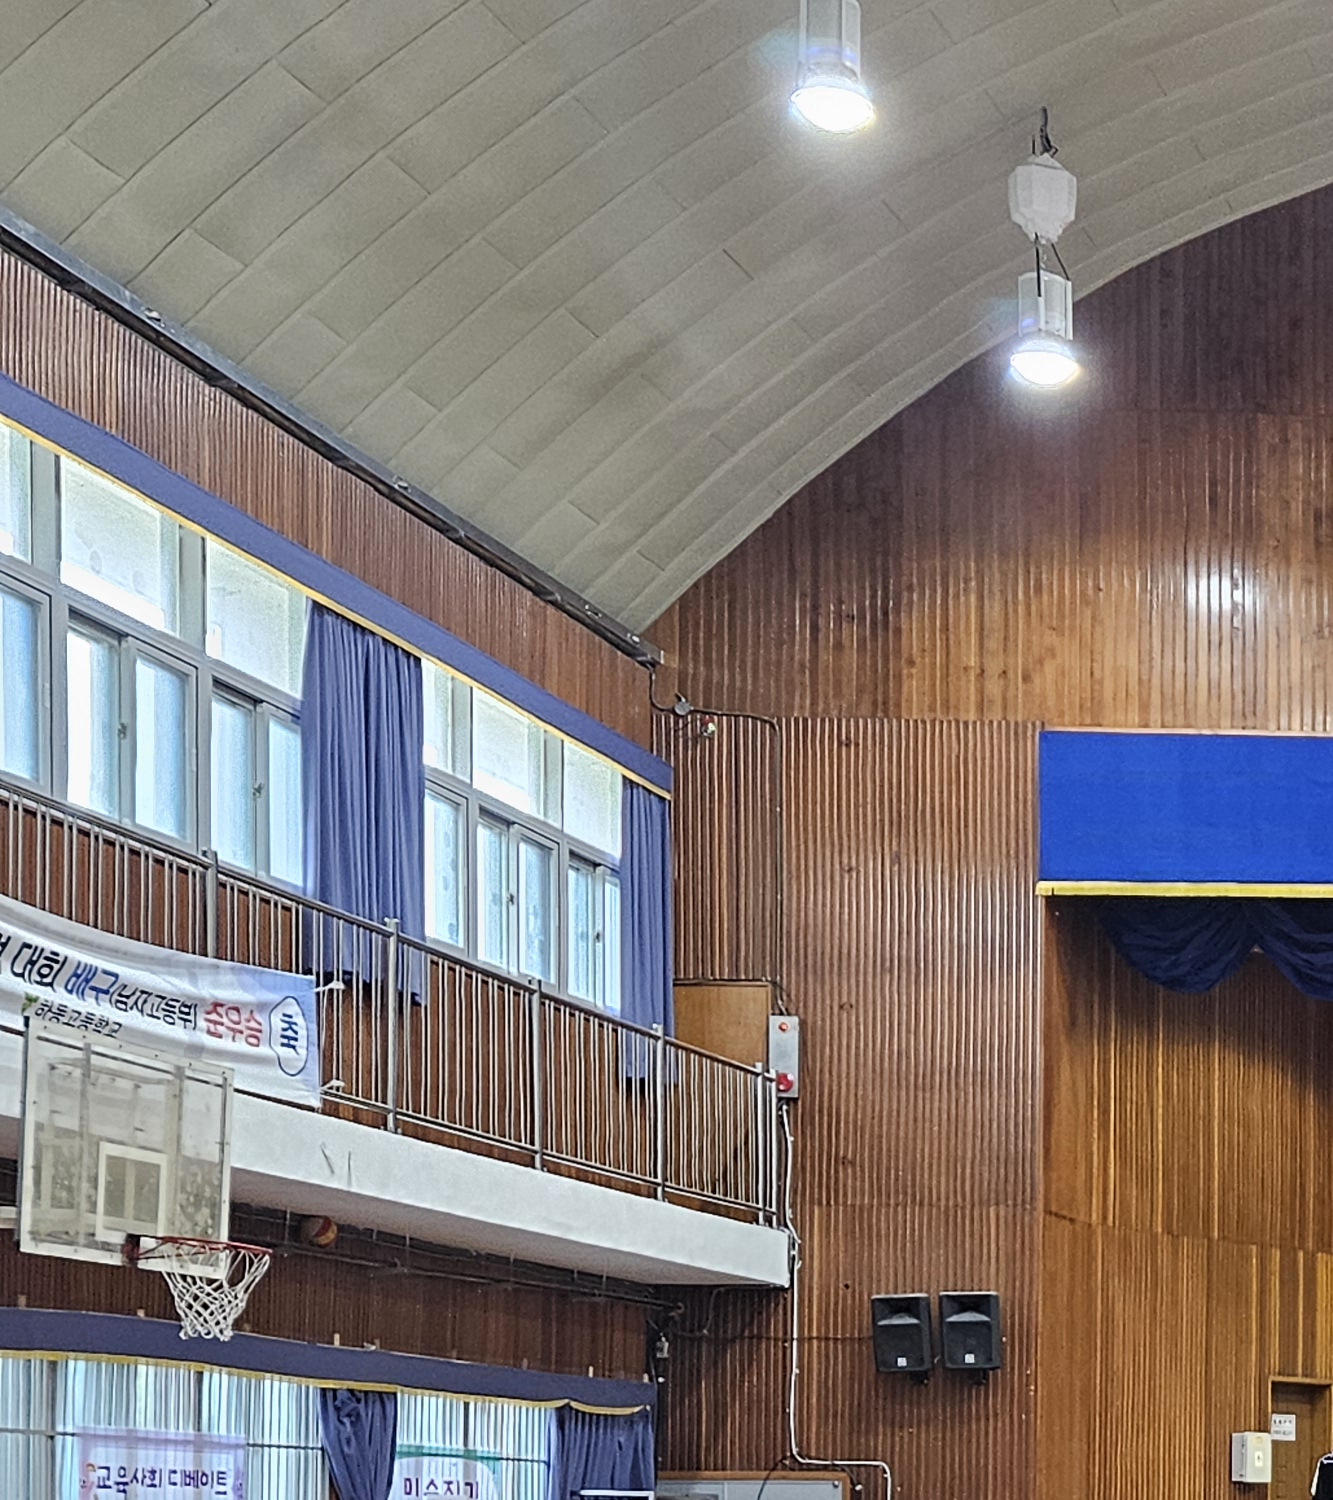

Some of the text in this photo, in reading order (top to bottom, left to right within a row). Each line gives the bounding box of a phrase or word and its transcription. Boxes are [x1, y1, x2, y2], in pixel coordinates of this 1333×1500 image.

[11, 942, 68, 993] 대회
[203, 1001, 263, 1049] 준우승
[34, 998, 123, 1038] 하동고등학교
[96, 1465, 228, 1500] 교육사회 디베이트
